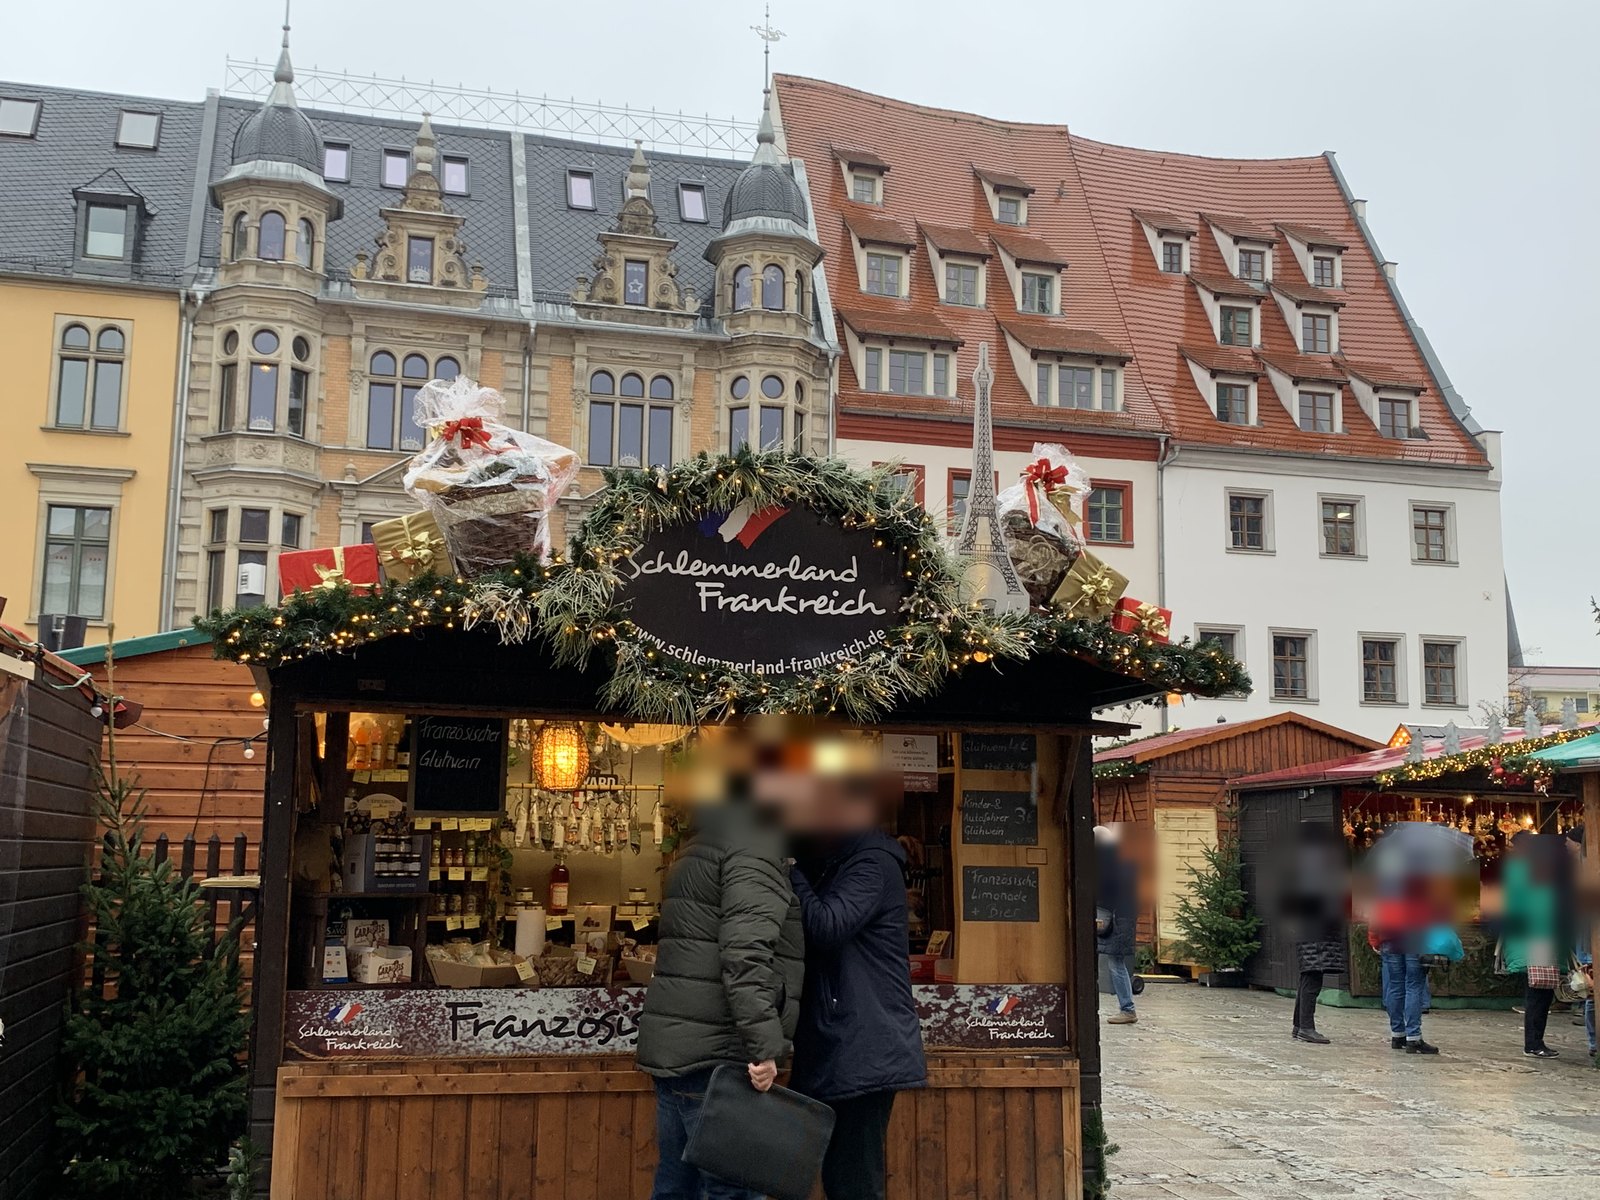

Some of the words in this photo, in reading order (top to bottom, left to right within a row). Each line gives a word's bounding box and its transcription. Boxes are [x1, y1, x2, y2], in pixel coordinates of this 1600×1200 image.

[626, 543, 858, 583] Schlemmerland
[695, 581, 886, 617] Frankreich
[632, 627, 887, 676] ww.schlemmerland-frankreich.de
[418, 749, 481, 769] Glühwein
[964, 825, 1005, 836] Glühwein
[971, 887, 1028, 903] Limonade
[965, 1016, 1045, 1030] Schlemmerland
[298, 1024, 393, 1040] Schlemmerland
[988, 1027, 1055, 1041] Frankreich
[325, 1037, 403, 1051] Frankreich
